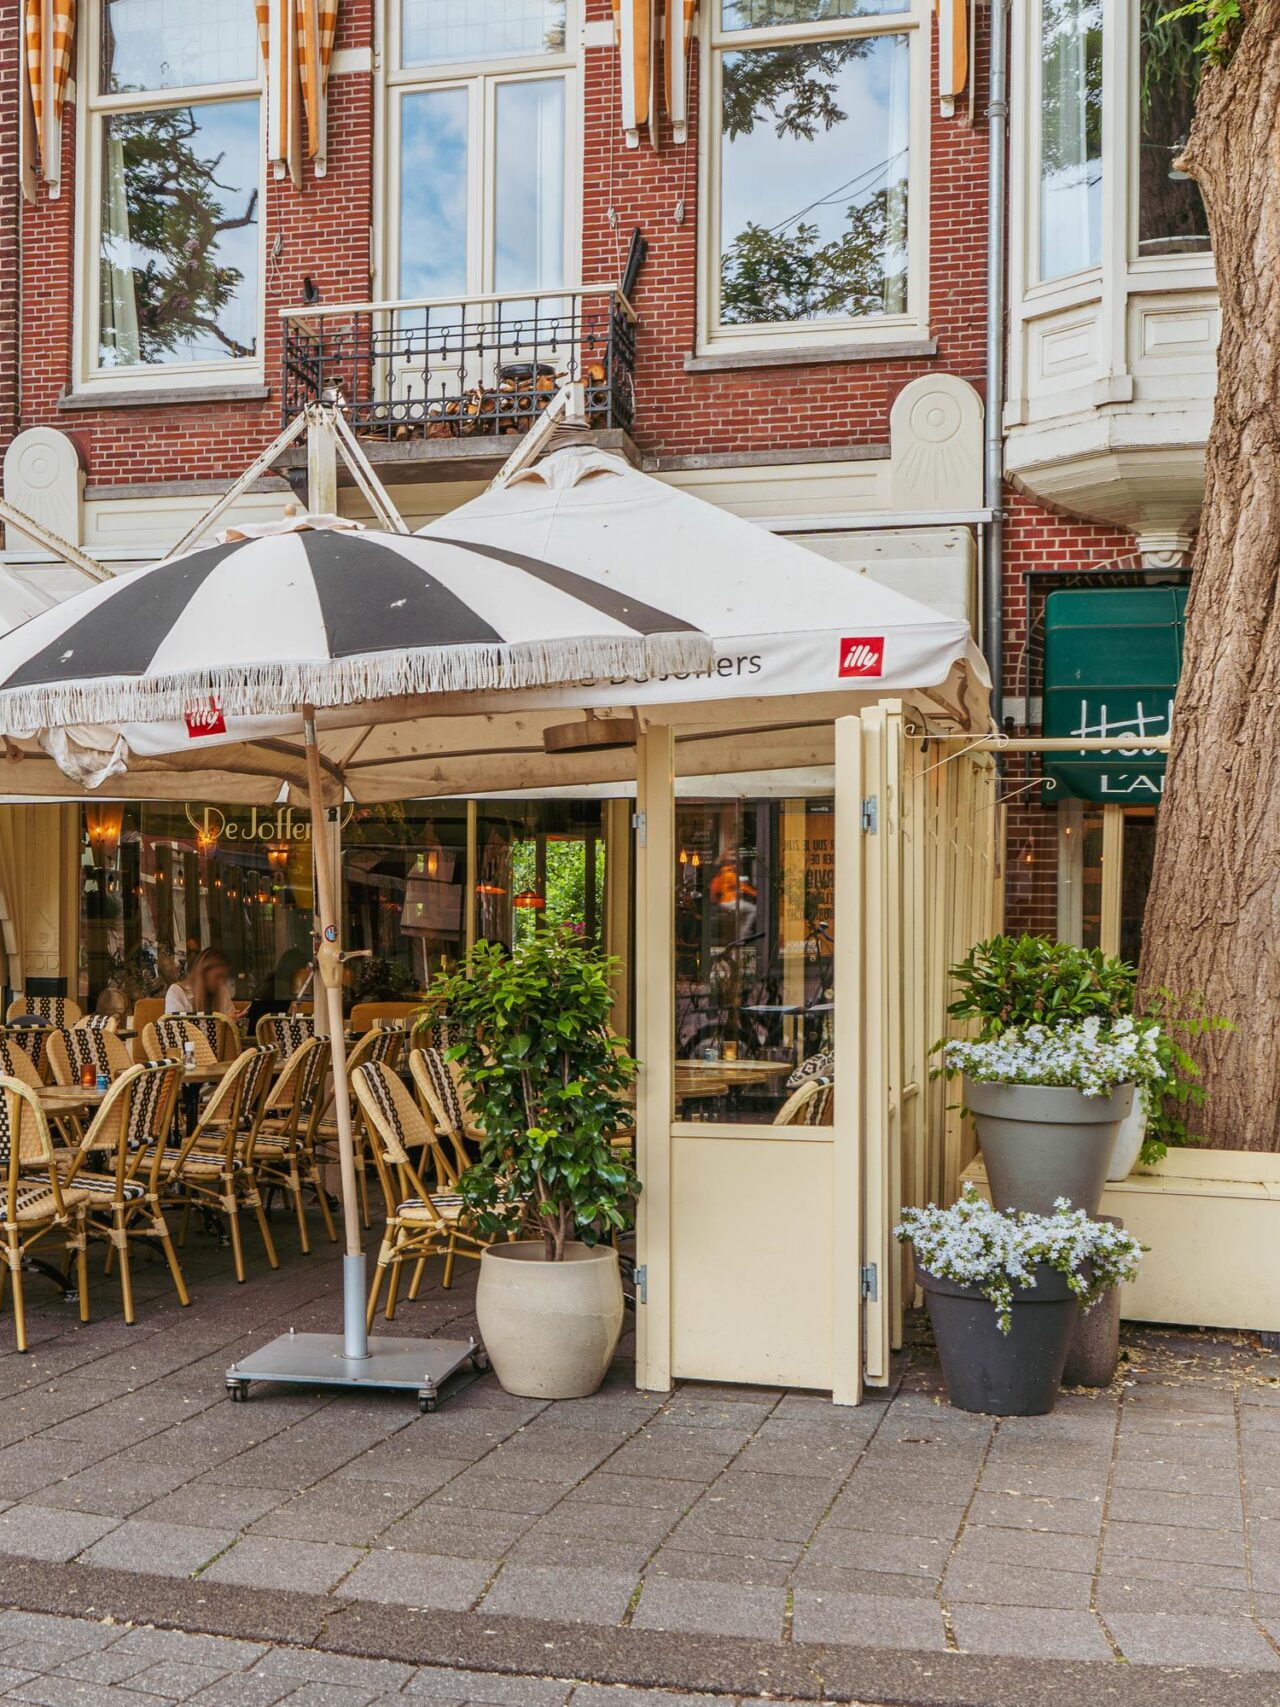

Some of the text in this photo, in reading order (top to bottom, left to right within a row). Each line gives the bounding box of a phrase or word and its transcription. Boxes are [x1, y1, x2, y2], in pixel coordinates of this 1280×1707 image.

[843, 644, 879, 672] illy
[203, 806, 313, 840] De Joffer
